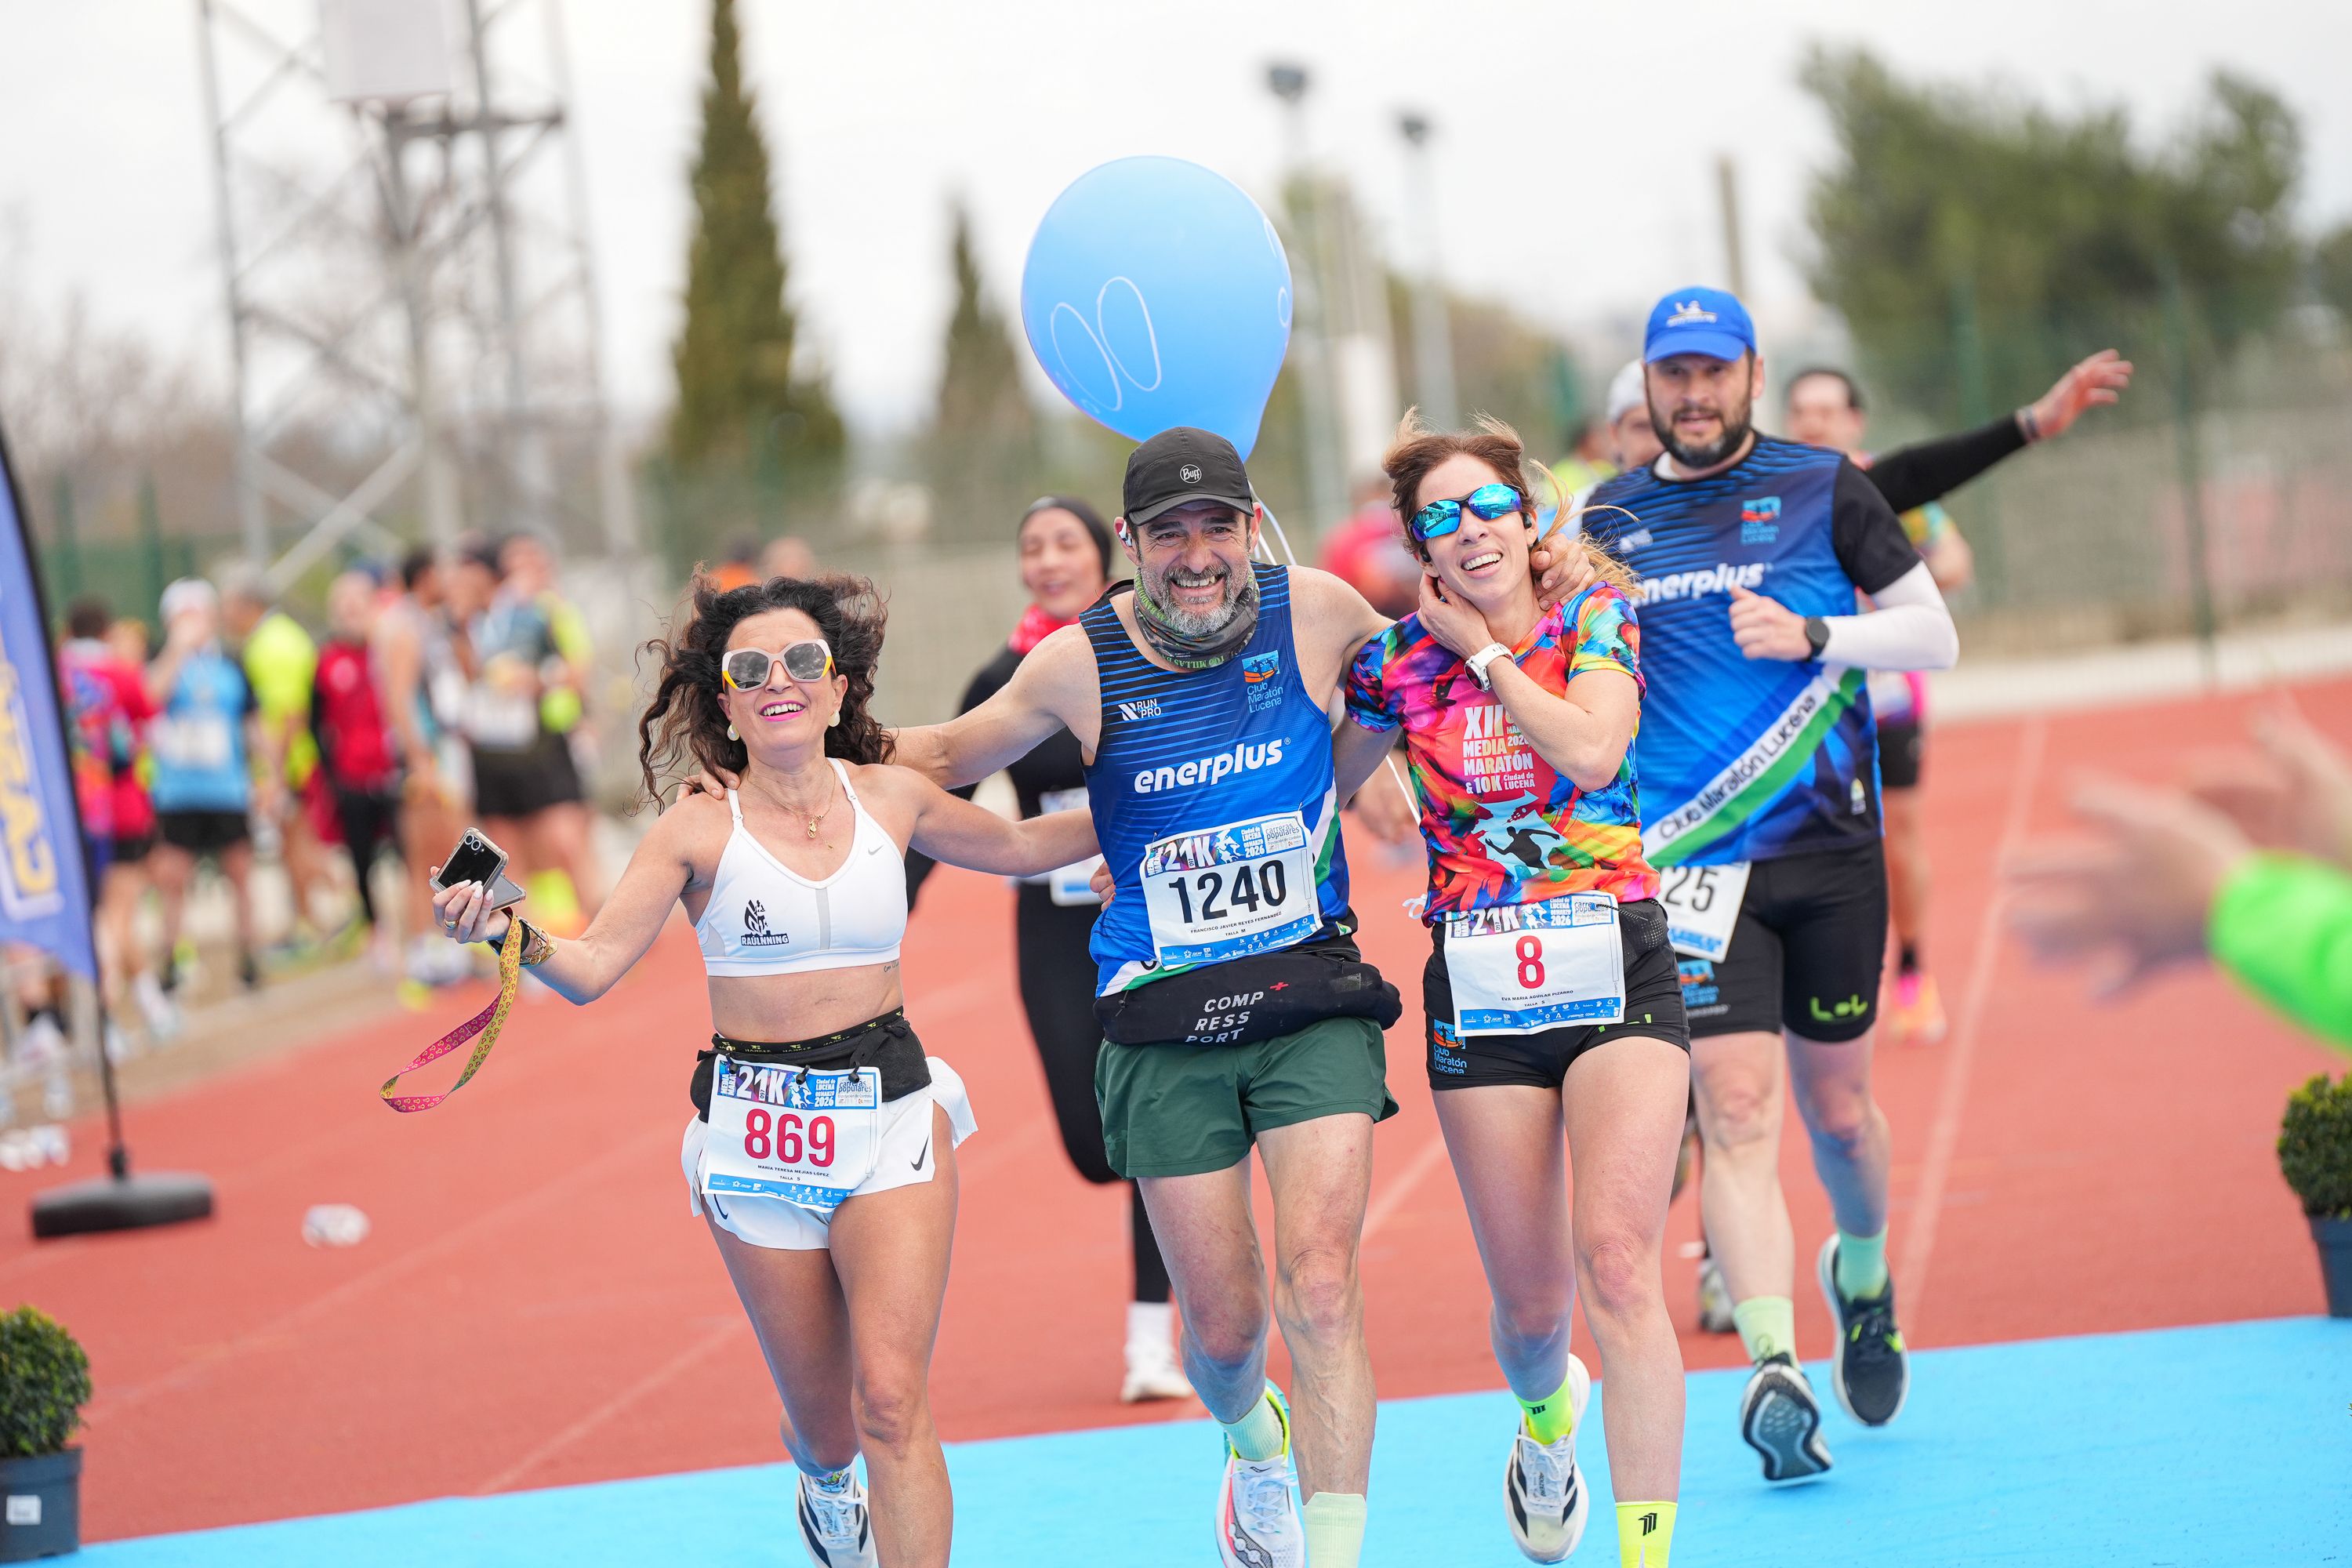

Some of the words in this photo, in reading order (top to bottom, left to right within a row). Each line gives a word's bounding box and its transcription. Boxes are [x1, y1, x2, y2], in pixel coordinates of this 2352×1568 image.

[1181, 468, 1200, 481] Buff
[1247, 681, 1268, 695] Club
[1247, 686, 1283, 705] Maratón
[1136, 698, 1158, 710] RUN
[1249, 697, 1282, 713] Lucena
[1141, 706, 1162, 719] PRO
[1463, 704, 1504, 740] XII
[1462, 737, 1507, 758] MEDIA
[1463, 750, 1534, 776] MARATÓN
[1658, 806, 1702, 840] Club
[1697, 753, 1767, 813] Maratón
[1764, 693, 1817, 758] Lucena
[1465, 782, 1474, 794] &
[1473, 775, 1503, 794] 10K
[1503, 772, 1525, 782] Ciudad
[1504, 779, 1536, 790] LUCENA
[1242, 832, 1262, 842] LUCENA
[1265, 823, 1294, 835] carreras
[1266, 826, 1300, 841] populares
[1163, 835, 1216, 871] 21K
[1245, 845, 1265, 858] 2026
[1168, 859, 1287, 924] 1240
[1471, 905, 1521, 935] 21K
[1550, 915, 1572, 927] 2026
[1515, 935, 1545, 989] 8
[1203, 991, 1265, 1013] COMP
[1194, 1011, 1250, 1032] RESS
[1185, 1027, 1244, 1044] PORT
[1433, 1044, 1450, 1057] Club
[1434, 1053, 1468, 1069] Maratón
[1435, 1060, 1465, 1075] Lucena
[736, 1065, 787, 1106] 21K
[838, 1085, 873, 1094] populares
[814, 1096, 834, 1108] 2026
[744, 1108, 835, 1167] 869
